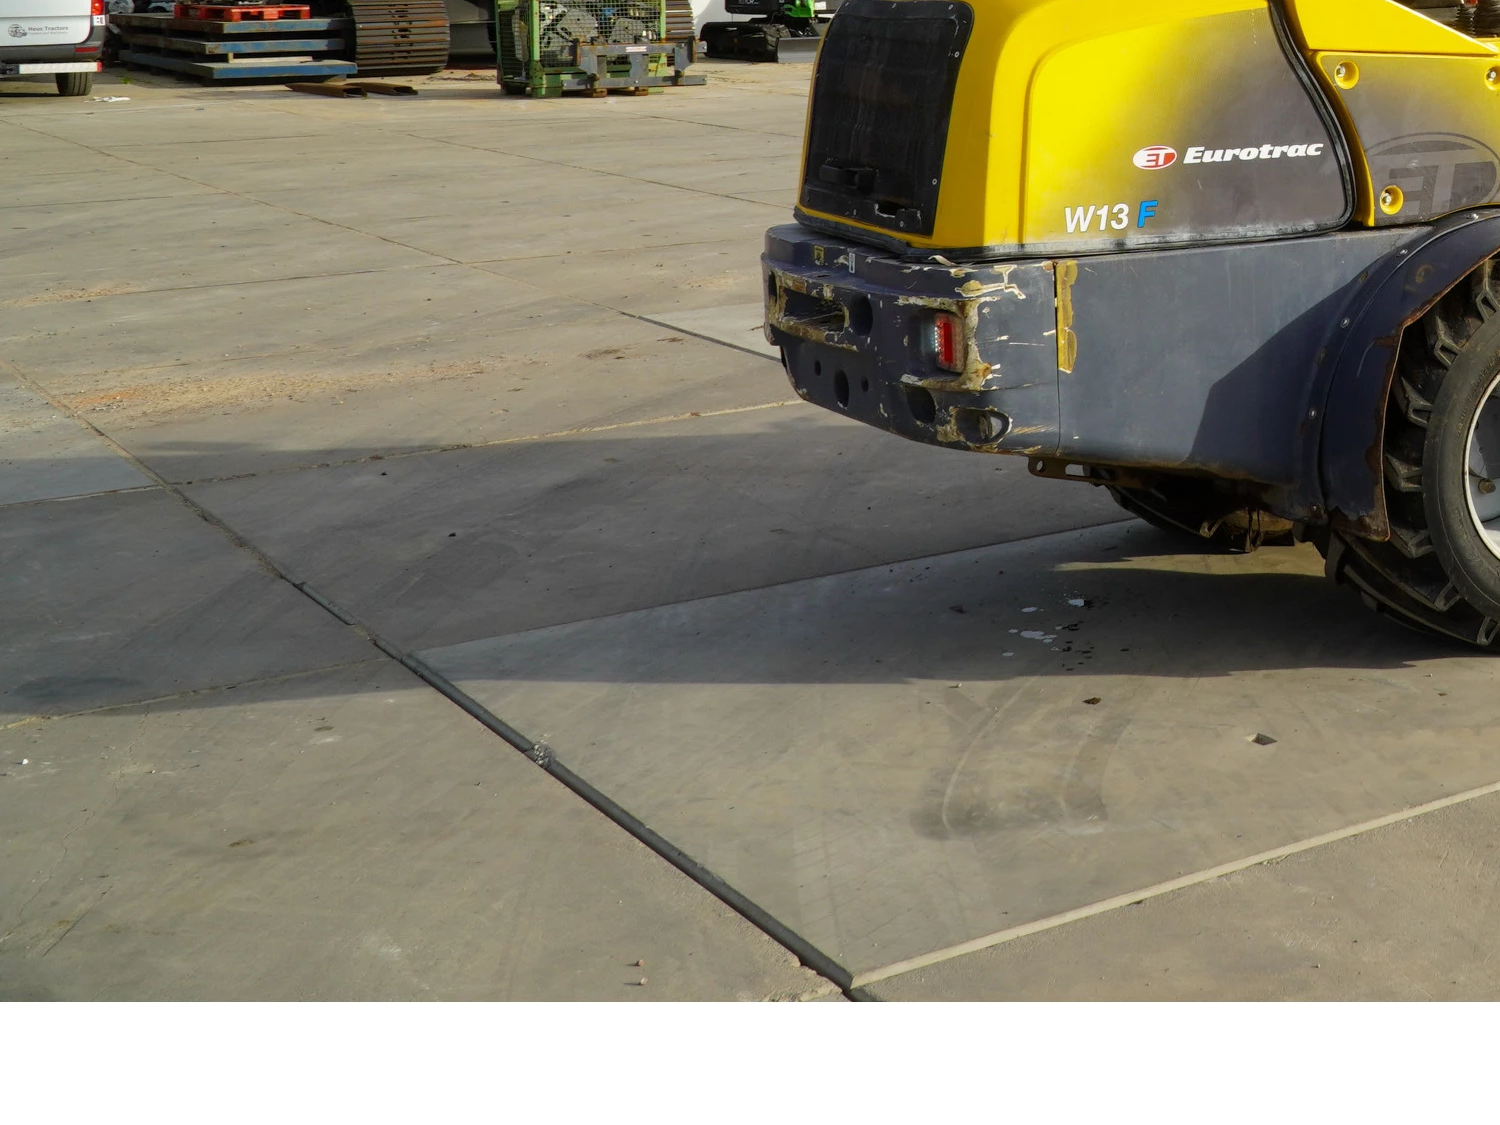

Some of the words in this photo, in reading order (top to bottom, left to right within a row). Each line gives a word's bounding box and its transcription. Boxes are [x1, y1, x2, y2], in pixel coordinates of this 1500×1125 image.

[1141, 147, 1173, 168] ET
[1183, 143, 1324, 165] Eurotrac
[1064, 203, 1129, 234] W13
[1137, 200, 1159, 228] F
